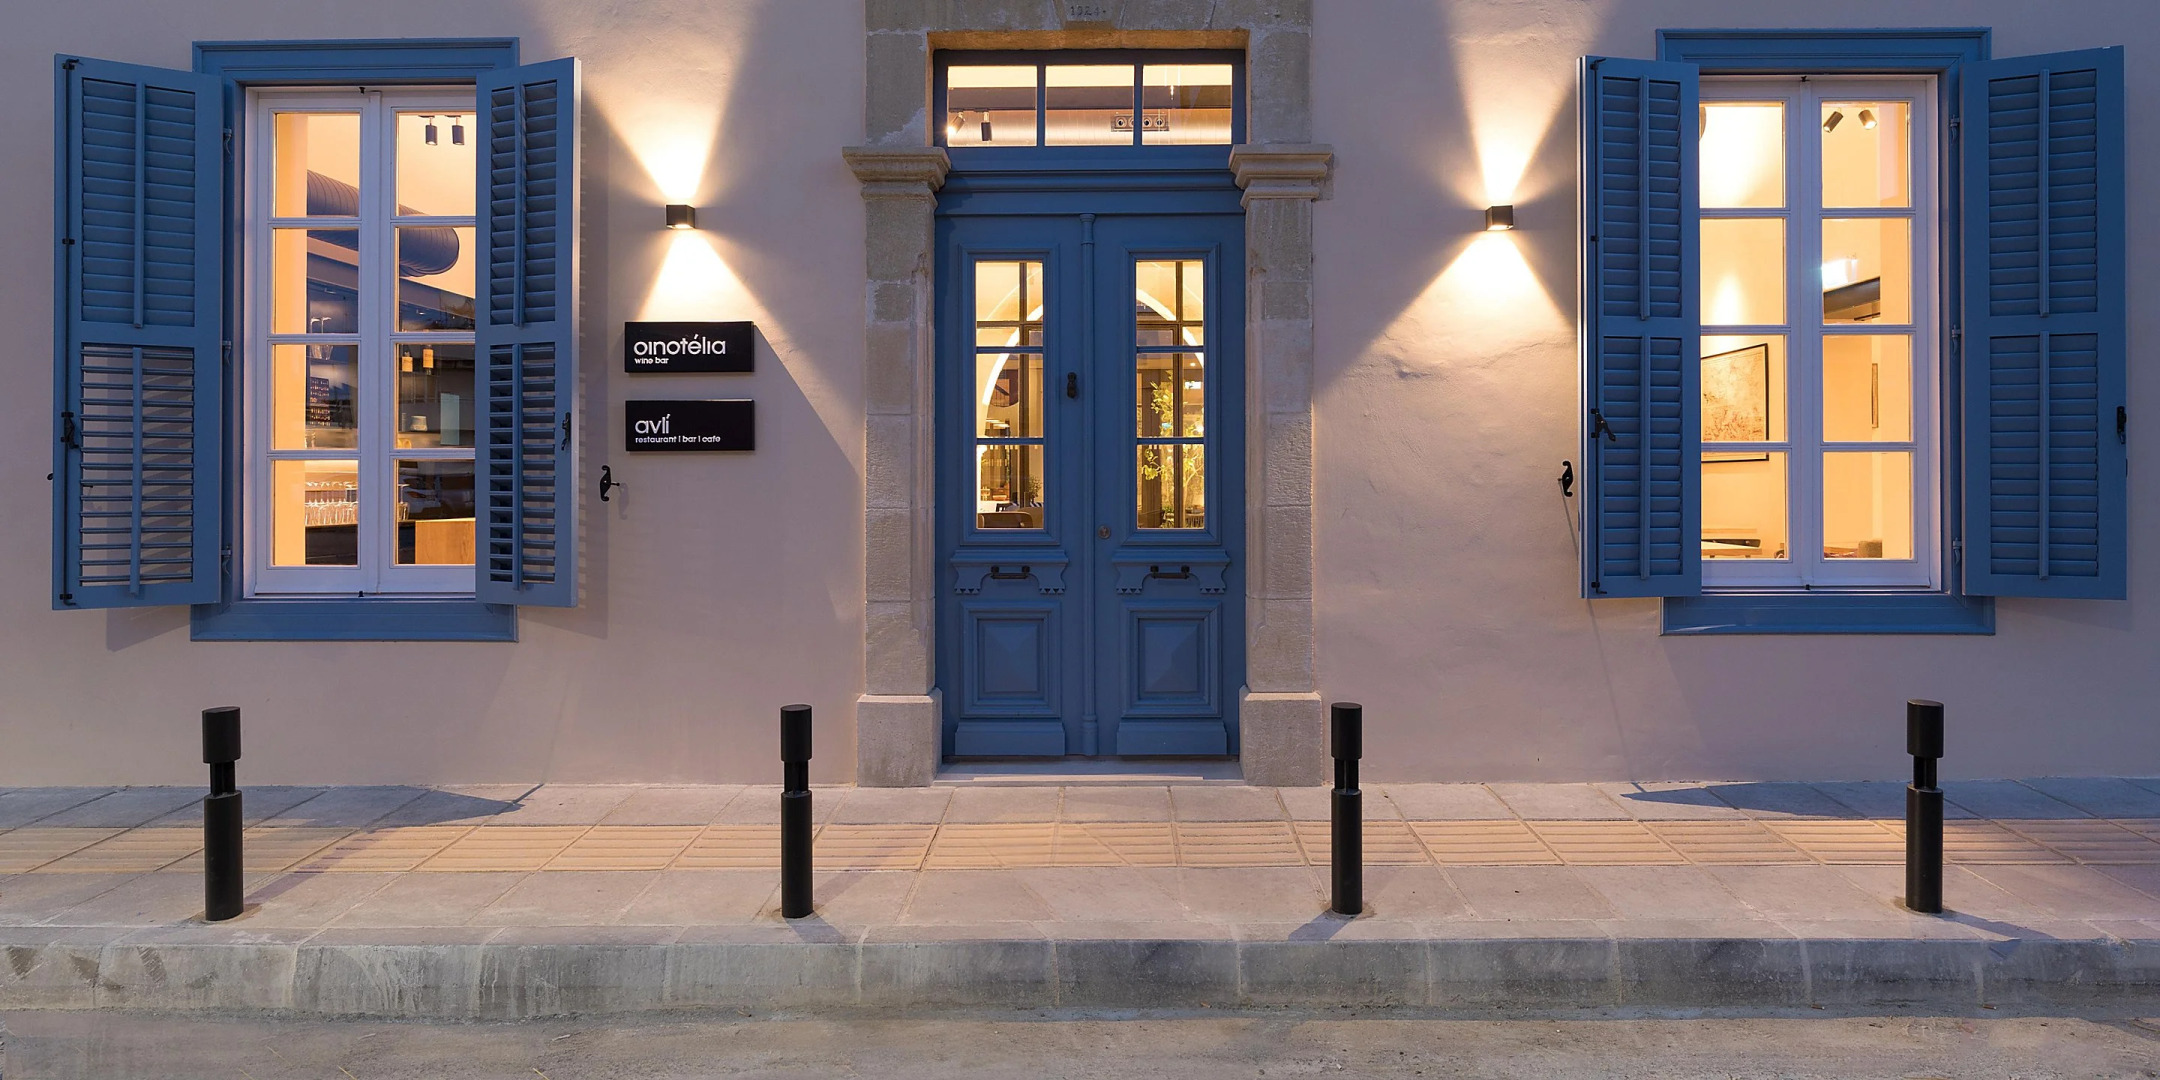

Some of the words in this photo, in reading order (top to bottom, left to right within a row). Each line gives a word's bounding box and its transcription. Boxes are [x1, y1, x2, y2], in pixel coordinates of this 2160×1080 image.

[634, 357, 654, 365] wine
[654, 357, 669, 365] bar
[635, 435, 677, 443] restaurant
[682, 435, 697, 443] bar
[702, 435, 721, 443] cafe
